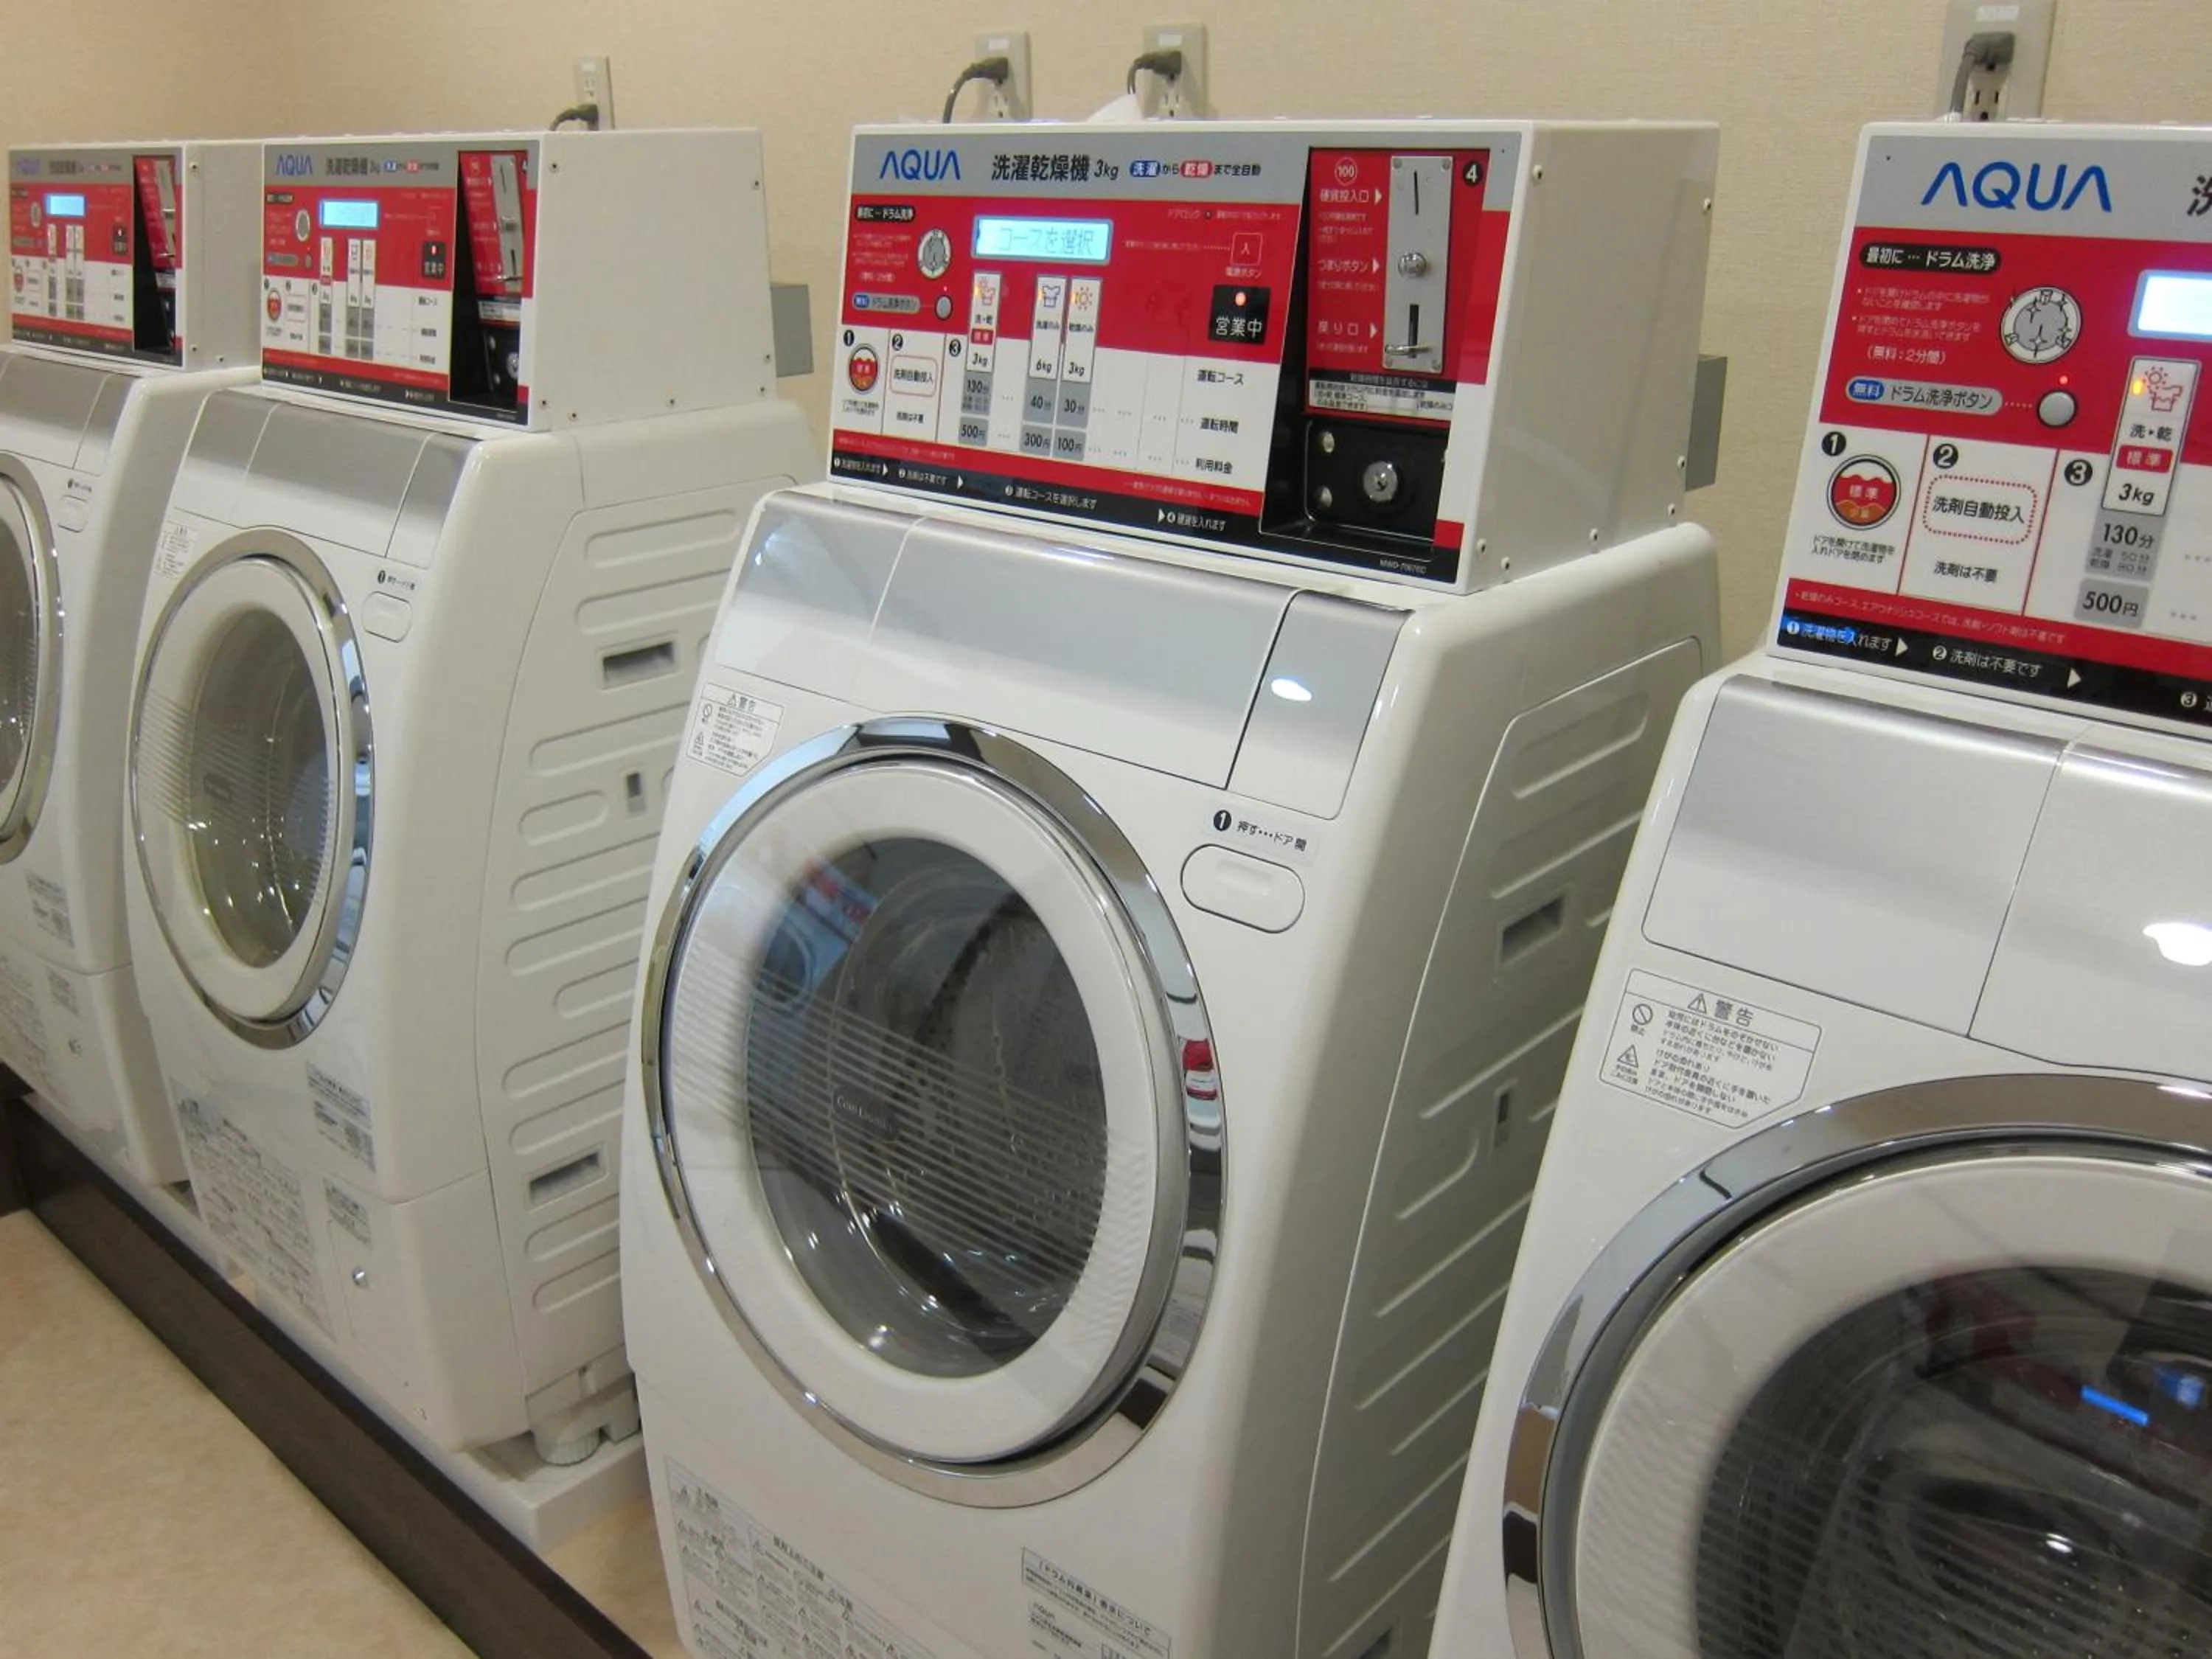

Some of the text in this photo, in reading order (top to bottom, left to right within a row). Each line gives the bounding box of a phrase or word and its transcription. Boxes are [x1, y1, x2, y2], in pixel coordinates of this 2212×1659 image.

[276, 154, 313, 175] AQUA
[880, 149, 961, 181] AQUA
[991, 154, 1119, 182] 洗濯乾燥機 3kg
[1337, 164, 1355, 178] 100
[1319, 189, 1370, 204] 硬貨投入口
[1921, 161, 2112, 213] AQUA
[998, 226, 1096, 257] コースを選択
[1215, 316, 1262, 338] 営業中
[1197, 369, 1244, 385] 運転コース
[1891, 385, 1993, 410] ドラム洗浄ボタン
[1200, 417, 1239, 434] 運転時間
[1195, 457, 1234, 474] 利用料金
[2118, 483, 2155, 507] 3kg
[1932, 495, 2025, 524] 洗剤自動投入
[2103, 523, 2155, 550] 130分
[1934, 560, 1998, 583] 洗剤は不要
[2082, 591, 2139, 617] 500円
[1950, 648, 2043, 678] 洗剤は不要です
[1714, 998, 1753, 1027] 警告
